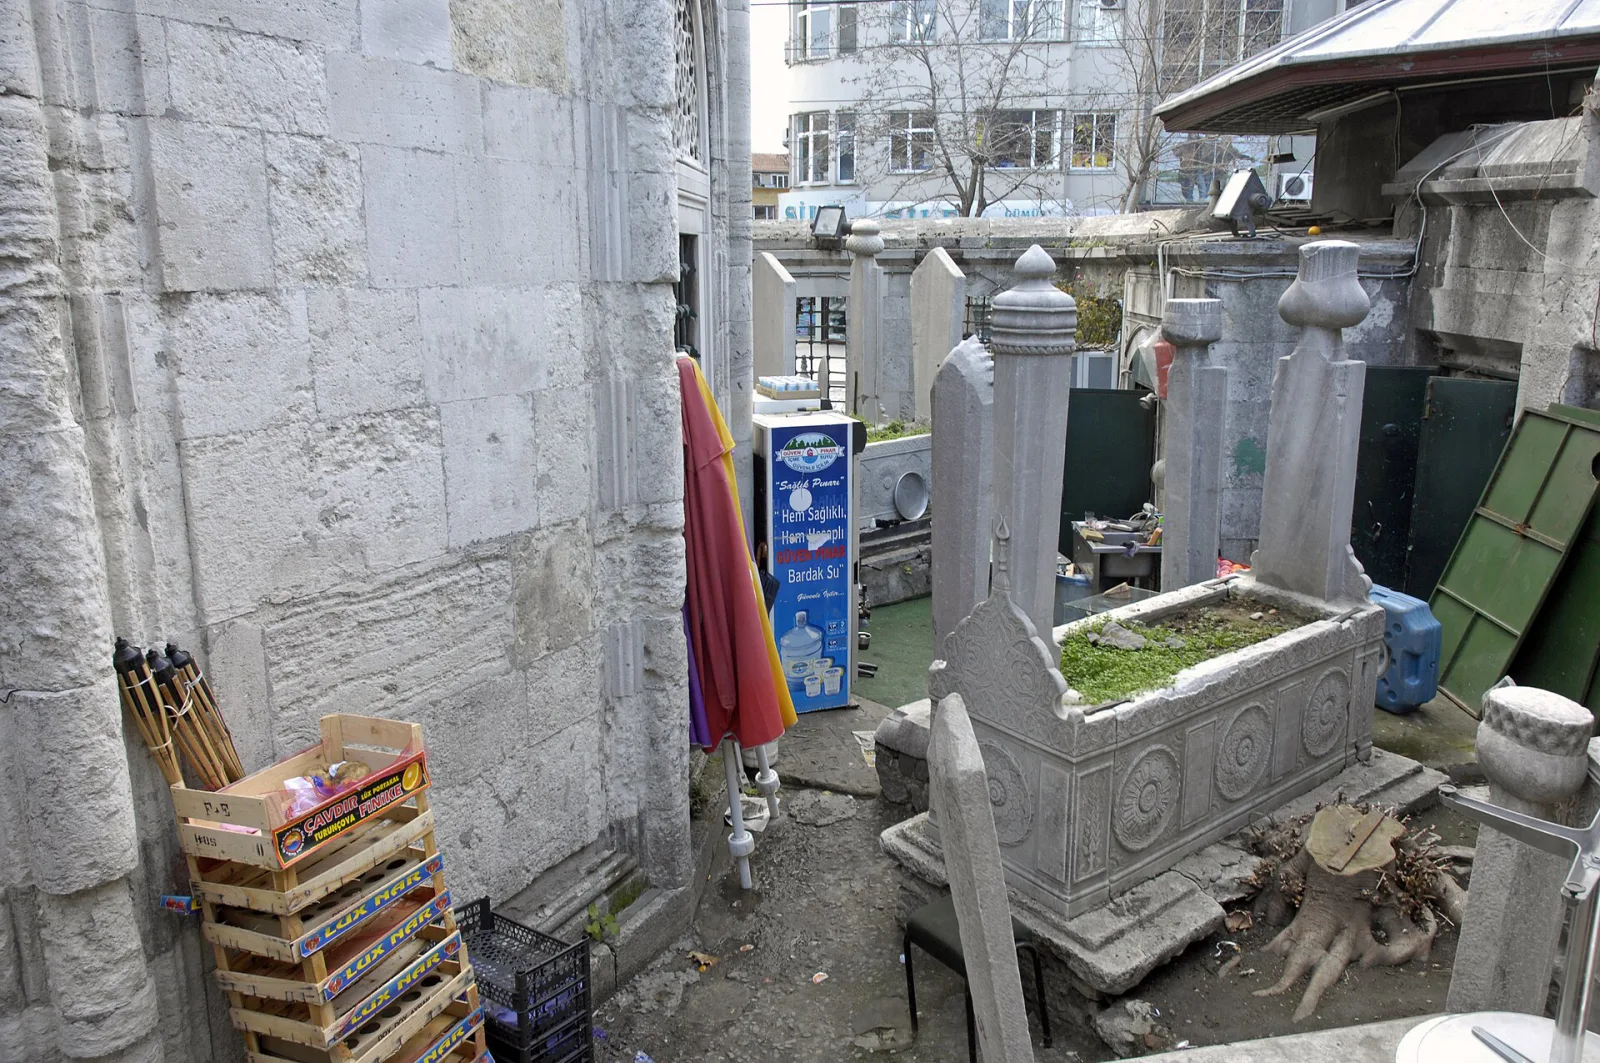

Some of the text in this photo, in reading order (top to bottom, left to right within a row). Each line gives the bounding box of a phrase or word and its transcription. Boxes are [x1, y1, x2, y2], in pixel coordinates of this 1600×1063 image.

[776, 545, 846, 565] GÜVEN PINAR
[788, 566, 824, 583] Bardak
[373, 776, 400, 794] PORTAKAL
[303, 795, 359, 837] ÇAVDIR
[313, 814, 356, 843] TURUNÇOVA
[324, 870, 422, 938] LUX NAR
[345, 907, 432, 980] LUX NAR
[351, 952, 441, 1025] LUX NAR
[422, 1025, 466, 1063] NAR
